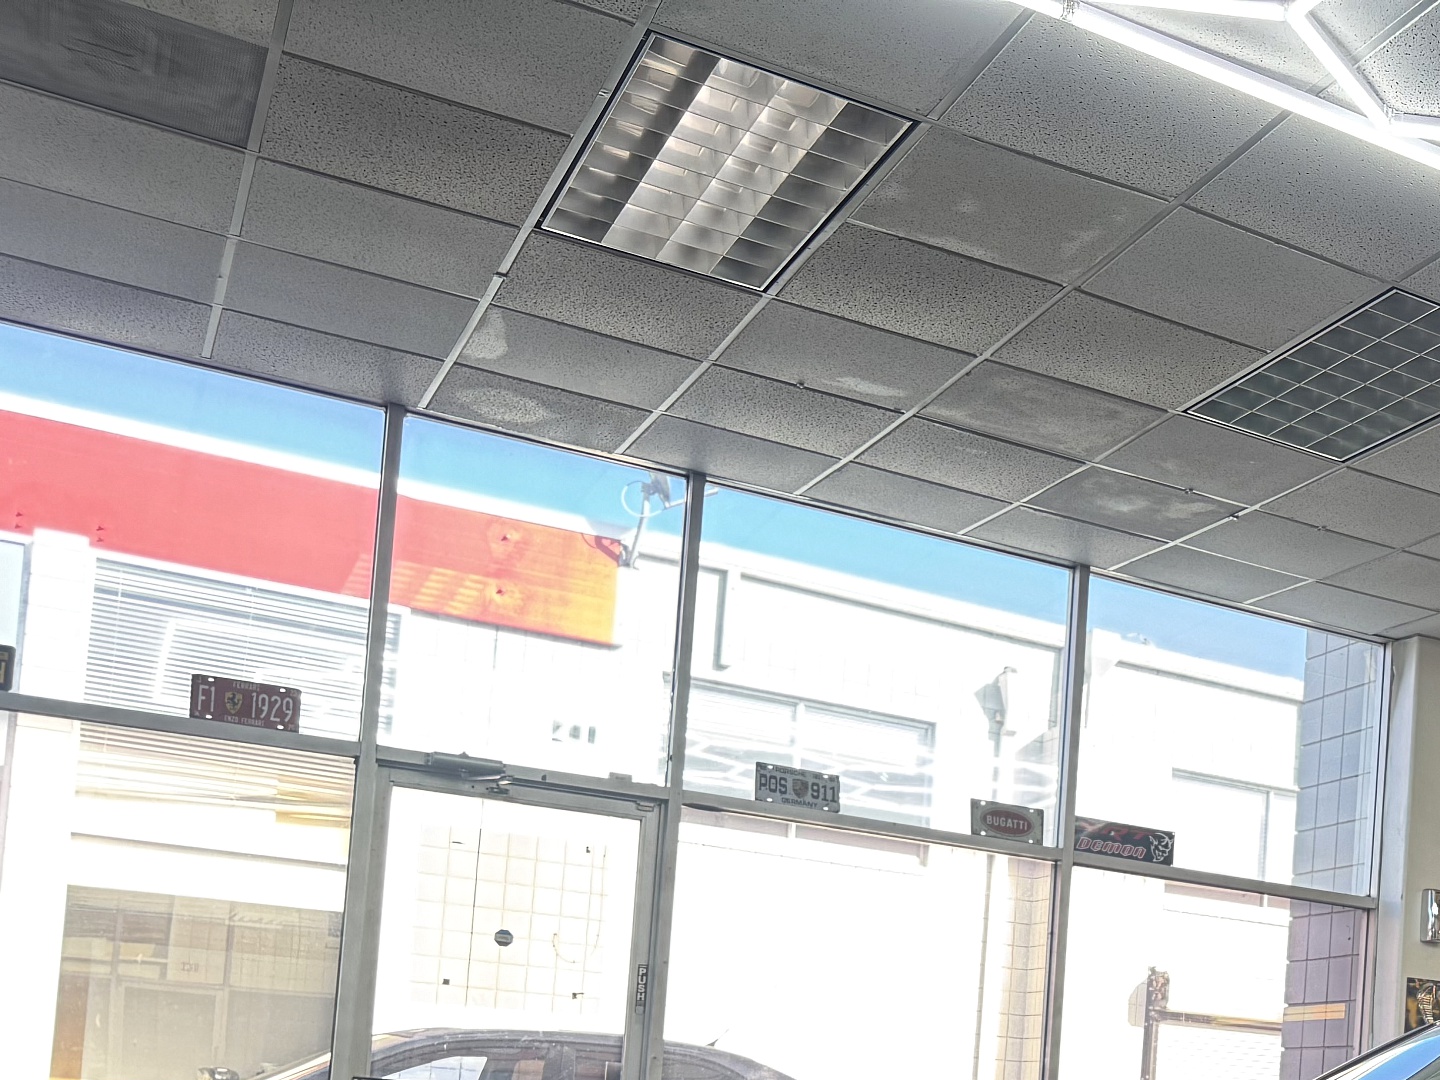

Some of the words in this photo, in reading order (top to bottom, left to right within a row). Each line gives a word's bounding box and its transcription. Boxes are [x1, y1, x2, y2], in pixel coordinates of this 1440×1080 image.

[198, 684, 215, 712] F1
[251, 692, 293, 722] 1929
[759, 773, 788, 795] POS
[810, 782, 837, 803] 911
[781, 797, 818, 809] GERMANY
[986, 814, 1028, 831] BUGATTI
[636, 967, 647, 1001] PUSH
